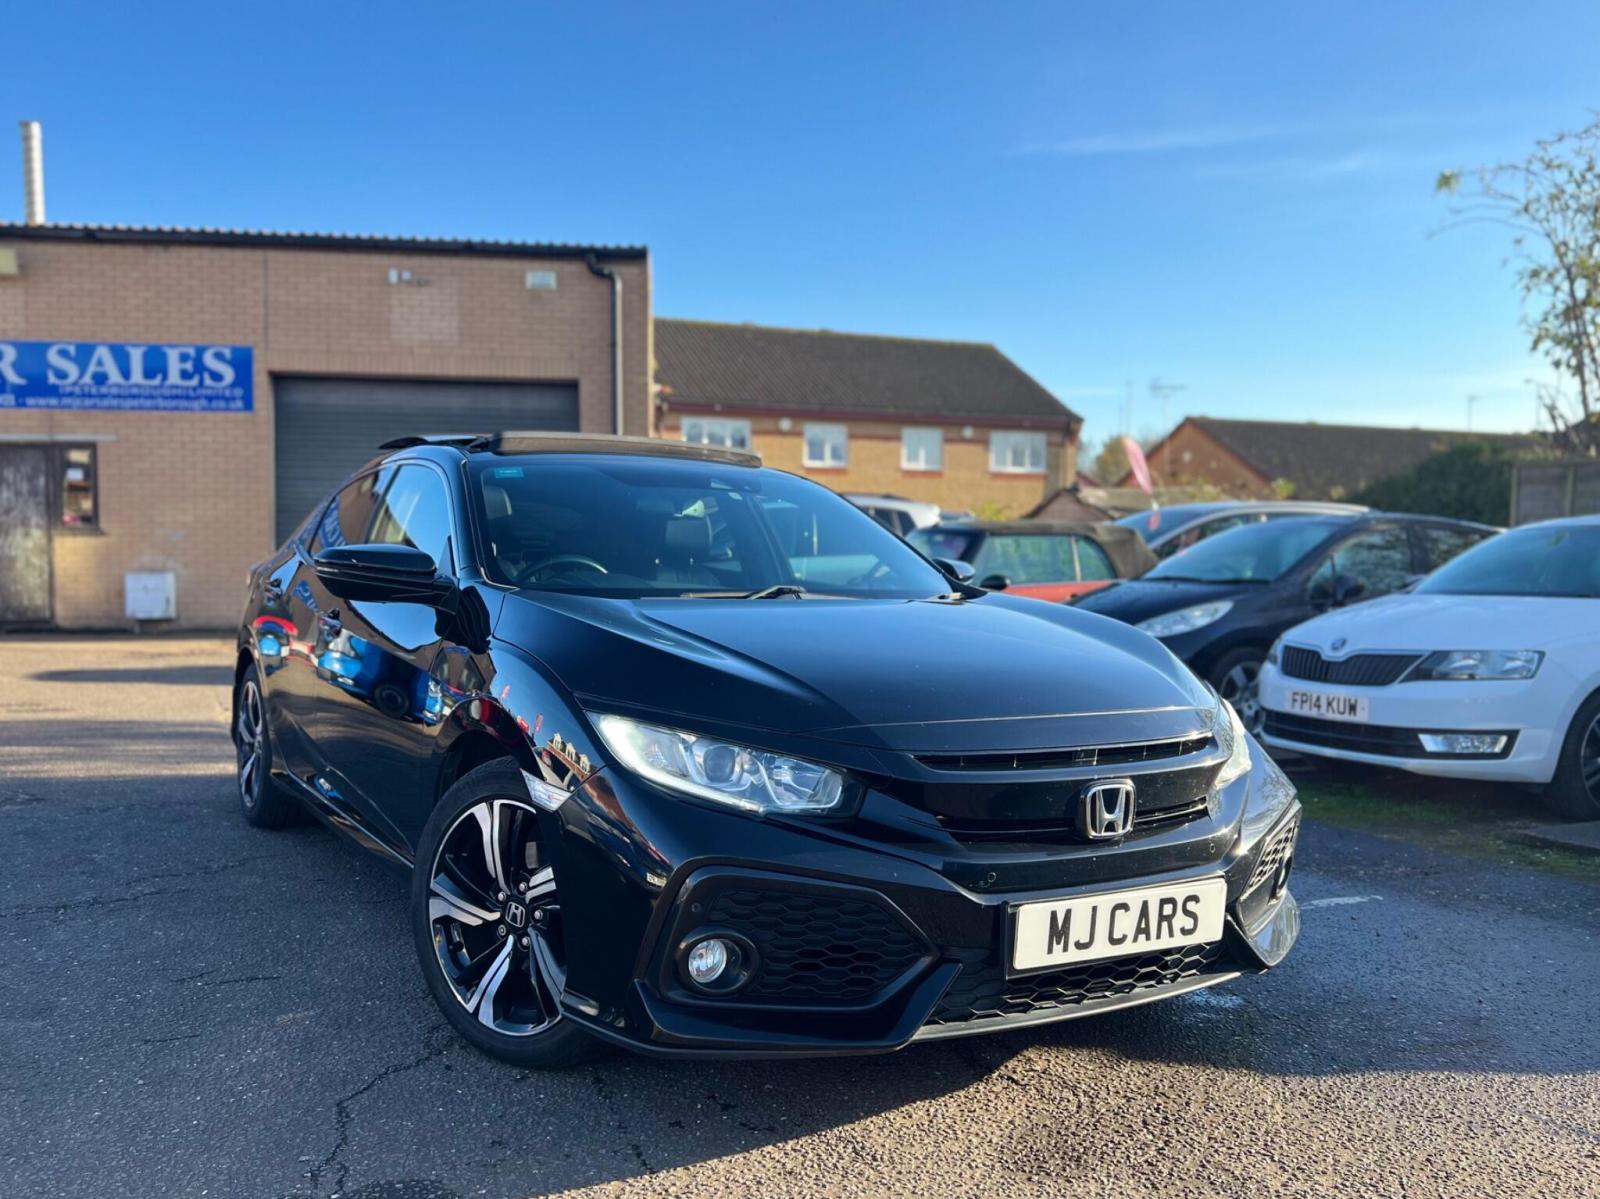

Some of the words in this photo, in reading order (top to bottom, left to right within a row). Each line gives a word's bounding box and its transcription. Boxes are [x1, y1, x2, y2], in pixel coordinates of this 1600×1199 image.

[46, 344, 236, 388] SALES
[1291, 691, 1322, 712] FP14
[1326, 695, 1358, 716] KUW
[1046, 905, 1098, 955] MJ
[1107, 894, 1200, 946] CARS
